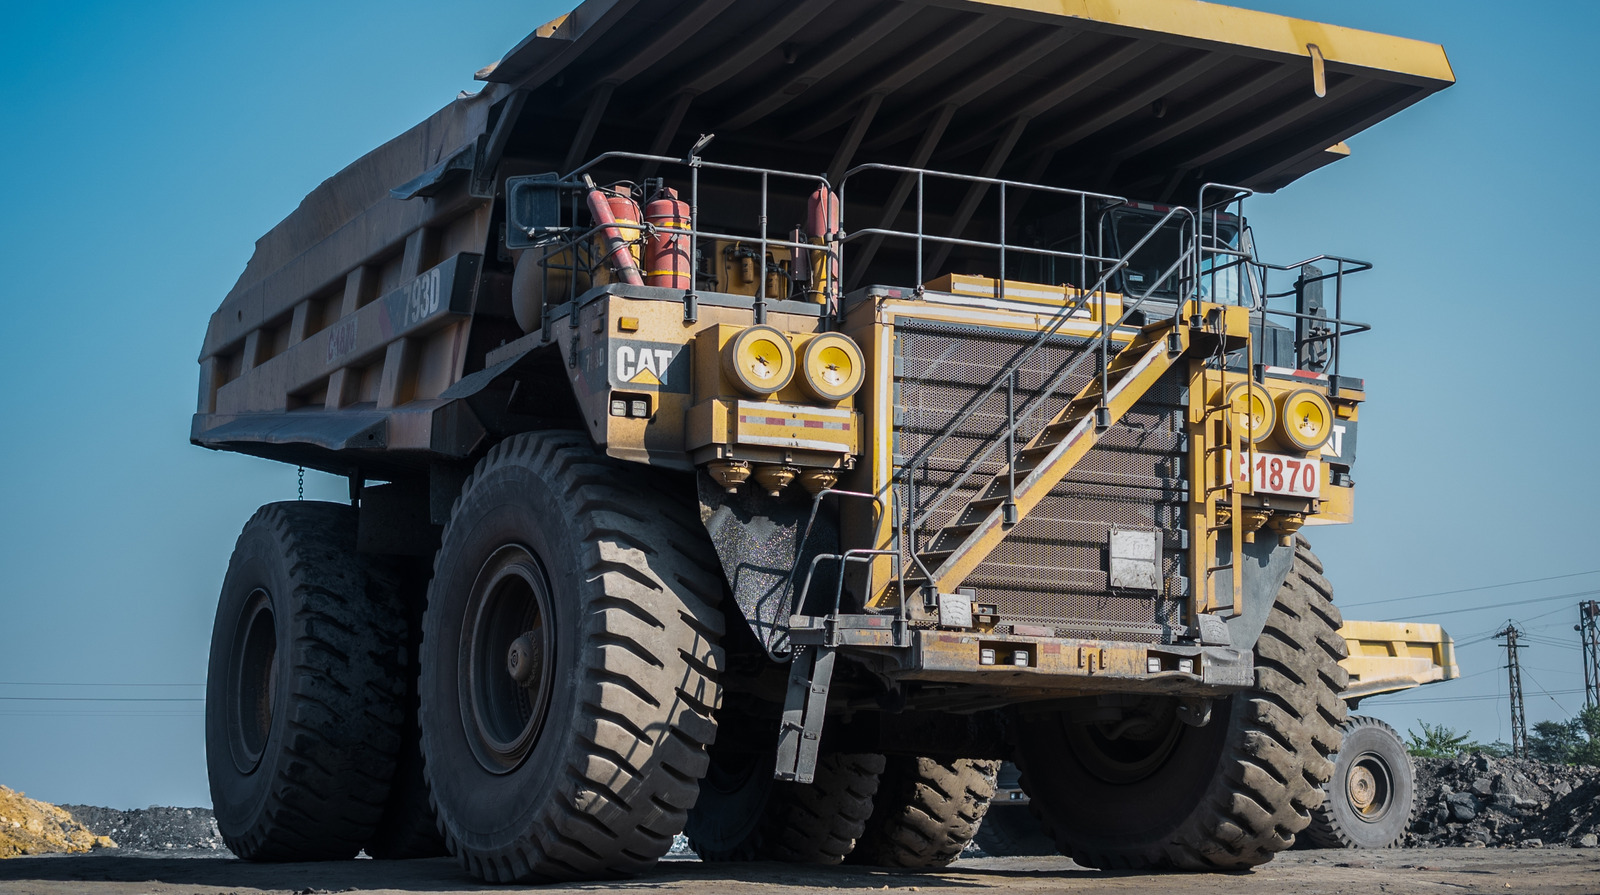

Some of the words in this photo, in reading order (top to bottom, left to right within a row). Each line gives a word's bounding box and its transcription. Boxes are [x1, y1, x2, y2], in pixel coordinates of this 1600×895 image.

[403, 268, 441, 327] 793D
[616, 345, 673, 386] CAT
[1230, 454, 1315, 493] C1870
